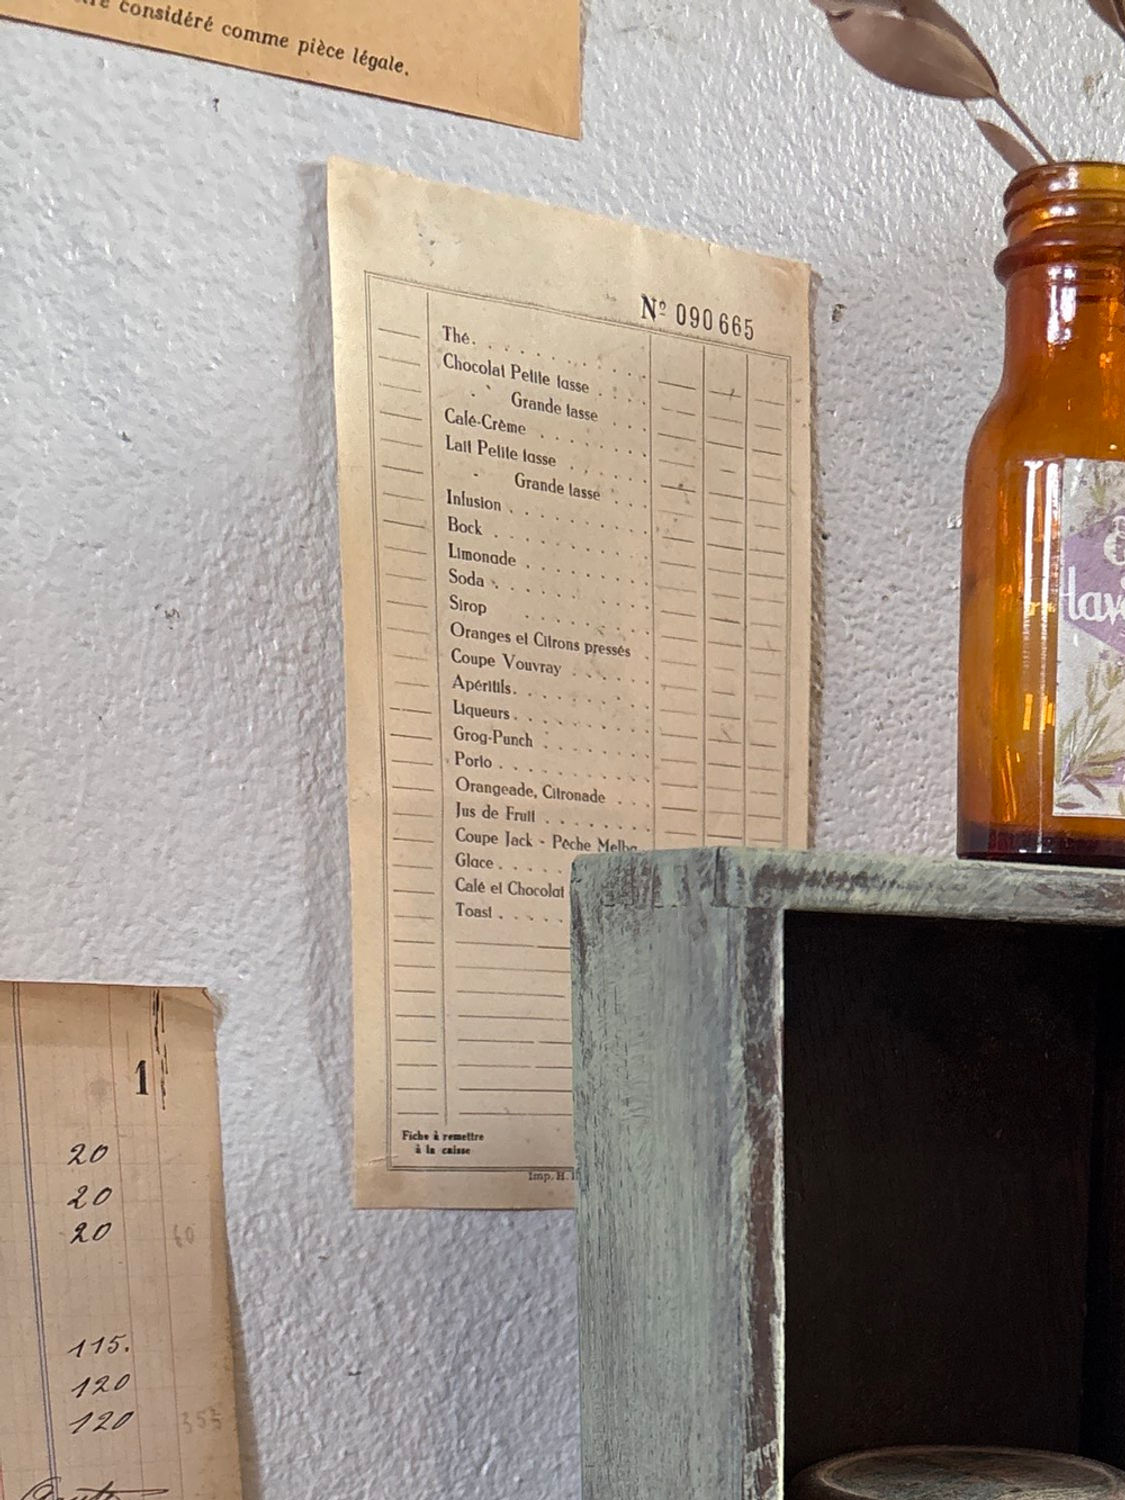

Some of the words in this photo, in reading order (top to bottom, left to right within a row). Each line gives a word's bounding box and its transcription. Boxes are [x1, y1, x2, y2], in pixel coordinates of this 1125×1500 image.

[119, 1, 214, 32] considéré
[222, 24, 290, 48] comme
[298, 38, 345, 60] pièce
[353, 47, 410, 76] légale.
[443, 352, 506, 378] Chocolat
[511, 363, 550, 386] Petite
[557, 375, 590, 394] tasse
[511, 391, 562, 415] Grande
[566, 404, 599, 422] tasse
[444, 407, 527, 435] Café-Crème
[445, 434, 472, 454] Lait
[477, 439, 518, 461] Petite
[523, 449, 557, 467] tasse
[515, 472, 565, 495] Grande
[569, 483, 601, 502] tasse
[446, 488, 502, 512] Infusion
[448, 516, 483, 536] Bock
[448, 543, 517, 567] Limonade
[449, 568, 485, 588] Soda
[449, 595, 487, 616] Sirop
[450, 622, 511, 644] Oranges
[516, 633, 529, 646] et
[533, 632, 580, 653] Citrons
[584, 640, 631, 658] pressés
[451, 648, 496, 668] Coupe
[502, 653, 562, 677] Vouvray
[452, 674, 512, 695] Apéritifs
[453, 699, 511, 721] Liqueurs
[453, 726, 533, 749] Grog-Punch
[455, 751, 493, 769] Porto
[455, 776, 538, 800] Orangeade,
[542, 784, 606, 804] Citronade
[455, 802, 476, 819] Jus
[482, 804, 499, 820] de
[506, 806, 536, 823] Fruit
[455, 827, 499, 847] Coupe
[505, 831, 534, 848] Jack
[552, 835, 592, 853] Pêche
[455, 852, 494, 870] Glace
[455, 877, 486, 894] Café
[490, 882, 503, 895] et
[508, 881, 565, 899] Chocolat
[456, 902, 493, 919] Toast
[402, 1130, 429, 1141] Fiche
[433, 1130, 440, 1141] à
[442, 1133, 485, 1142] remettre
[67, 1143, 109, 1166] 20
[415, 1145, 421, 1154] à
[426, 1145, 435, 1155] la
[442, 1145, 471, 1155] caisse
[67, 1184, 113, 1210] 20
[70, 1222, 112, 1245] 20
[71, 1373, 131, 1398] 120
[69, 1410, 135, 1435] 120
